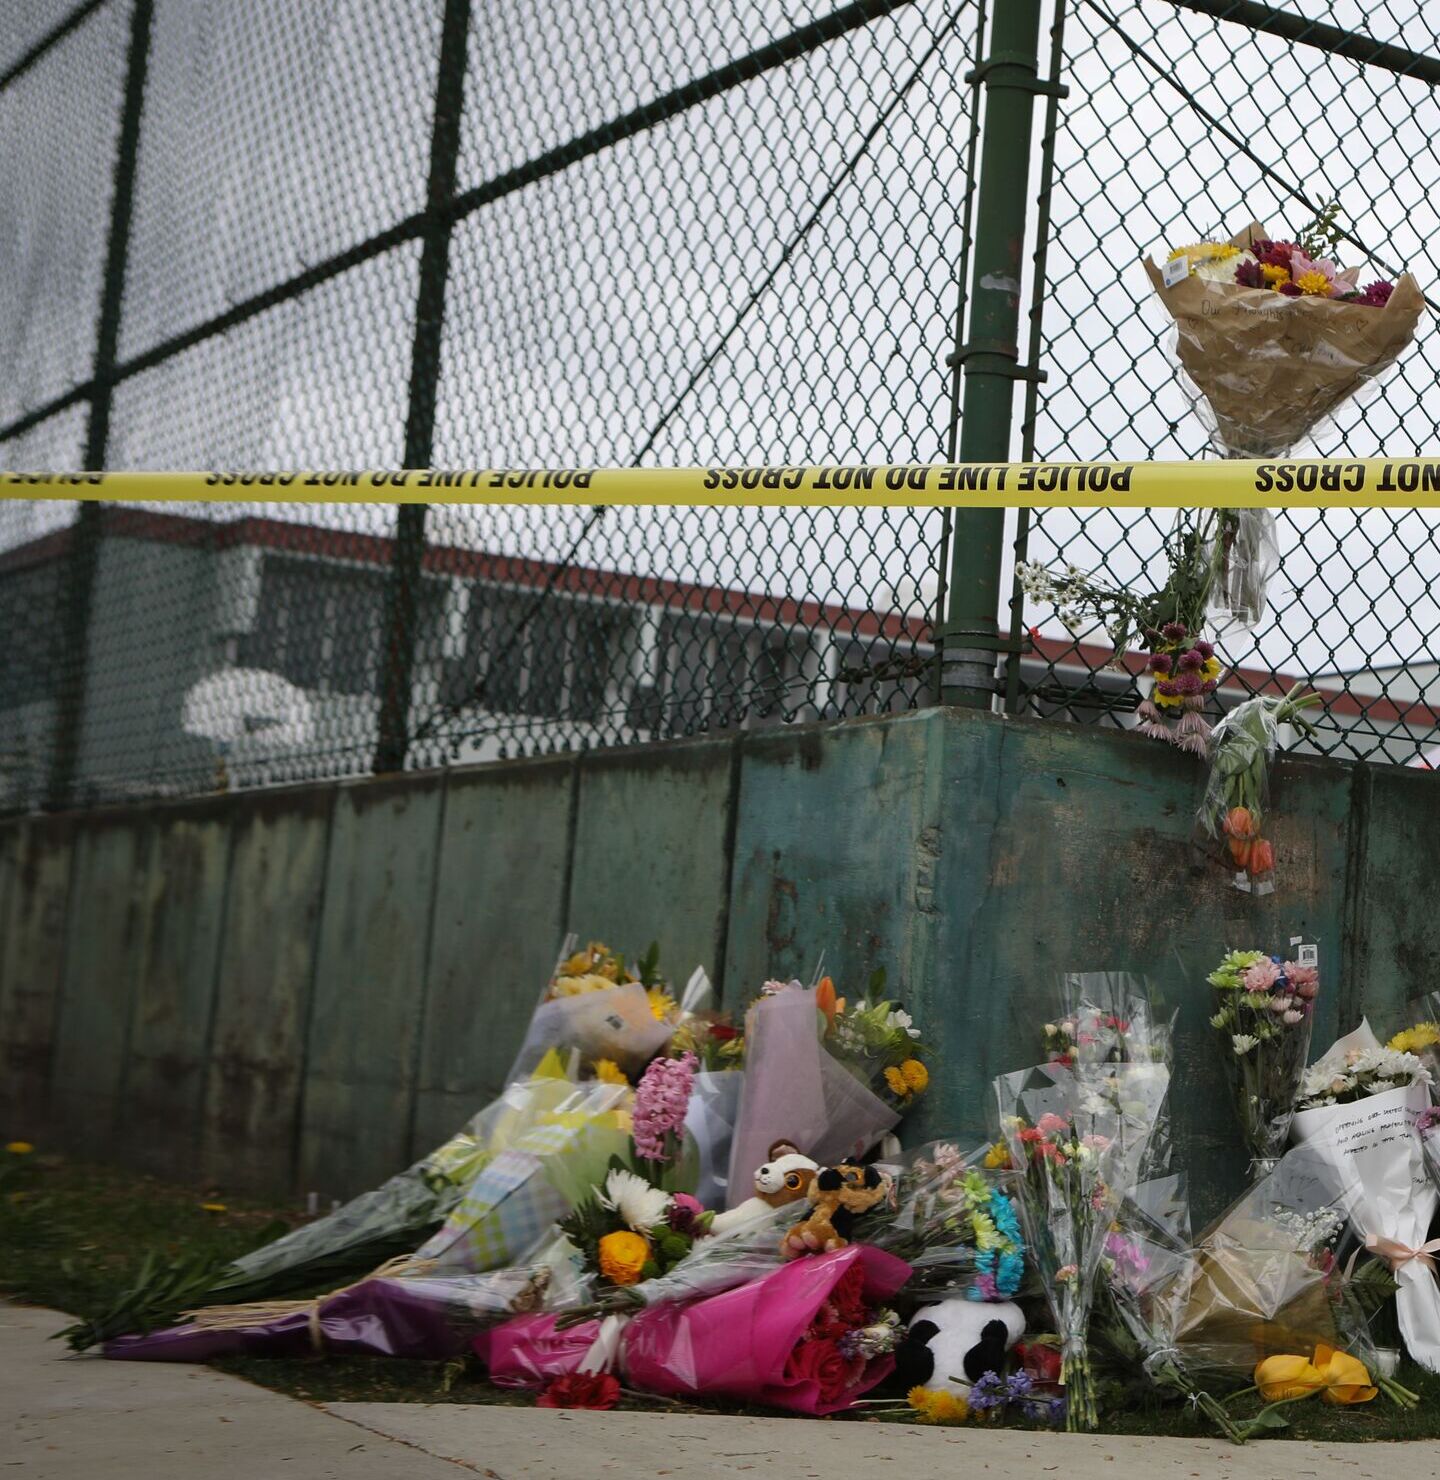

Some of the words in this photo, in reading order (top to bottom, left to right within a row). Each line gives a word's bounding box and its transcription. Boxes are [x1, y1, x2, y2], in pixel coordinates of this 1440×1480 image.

[703, 468, 807, 490] CROSS
[812, 467, 878, 490] NOT
[886, 467, 931, 491] DO
[939, 467, 1010, 491] LINE
[1018, 466, 1133, 492] POLICE
[1254, 464, 1366, 493] CROSS
